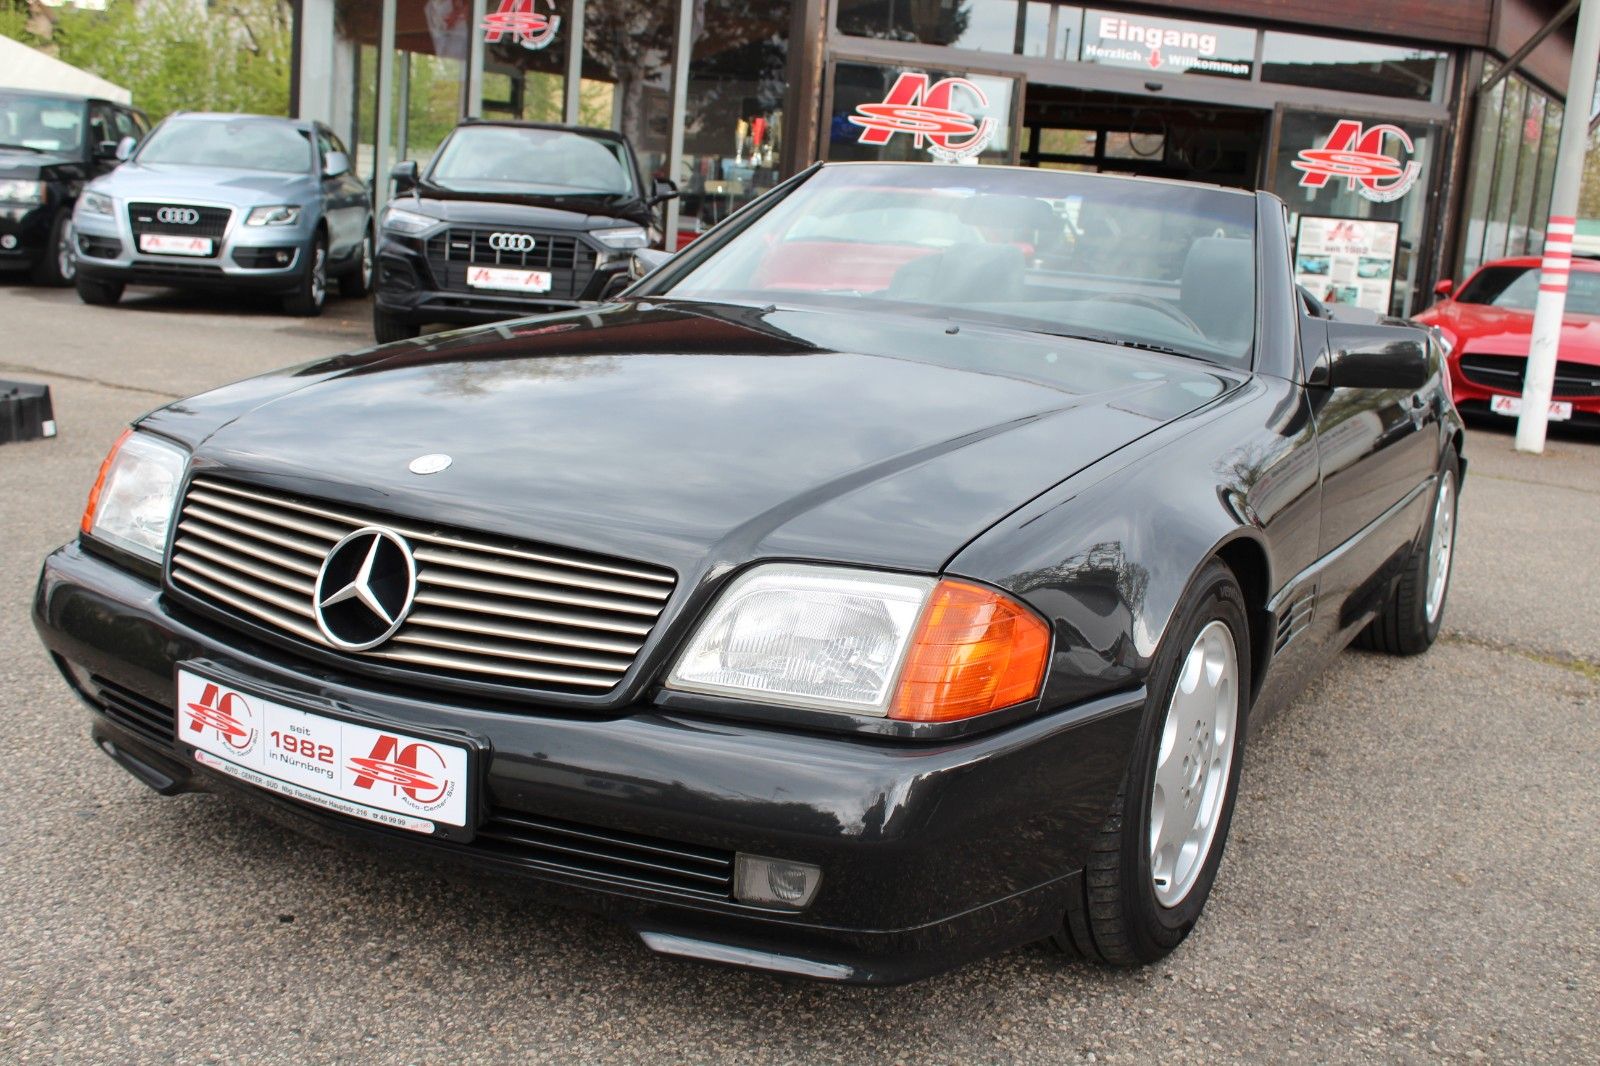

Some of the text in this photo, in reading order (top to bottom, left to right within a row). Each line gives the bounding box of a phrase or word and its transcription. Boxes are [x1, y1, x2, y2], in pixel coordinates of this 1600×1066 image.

[1098, 16, 1217, 55] Eingang
[1086, 44, 1250, 75] Herzlich Willkommen
[289, 724, 311, 736] seit
[270, 730, 334, 765] 1982
[269, 748, 334, 779] in Nürnberg
